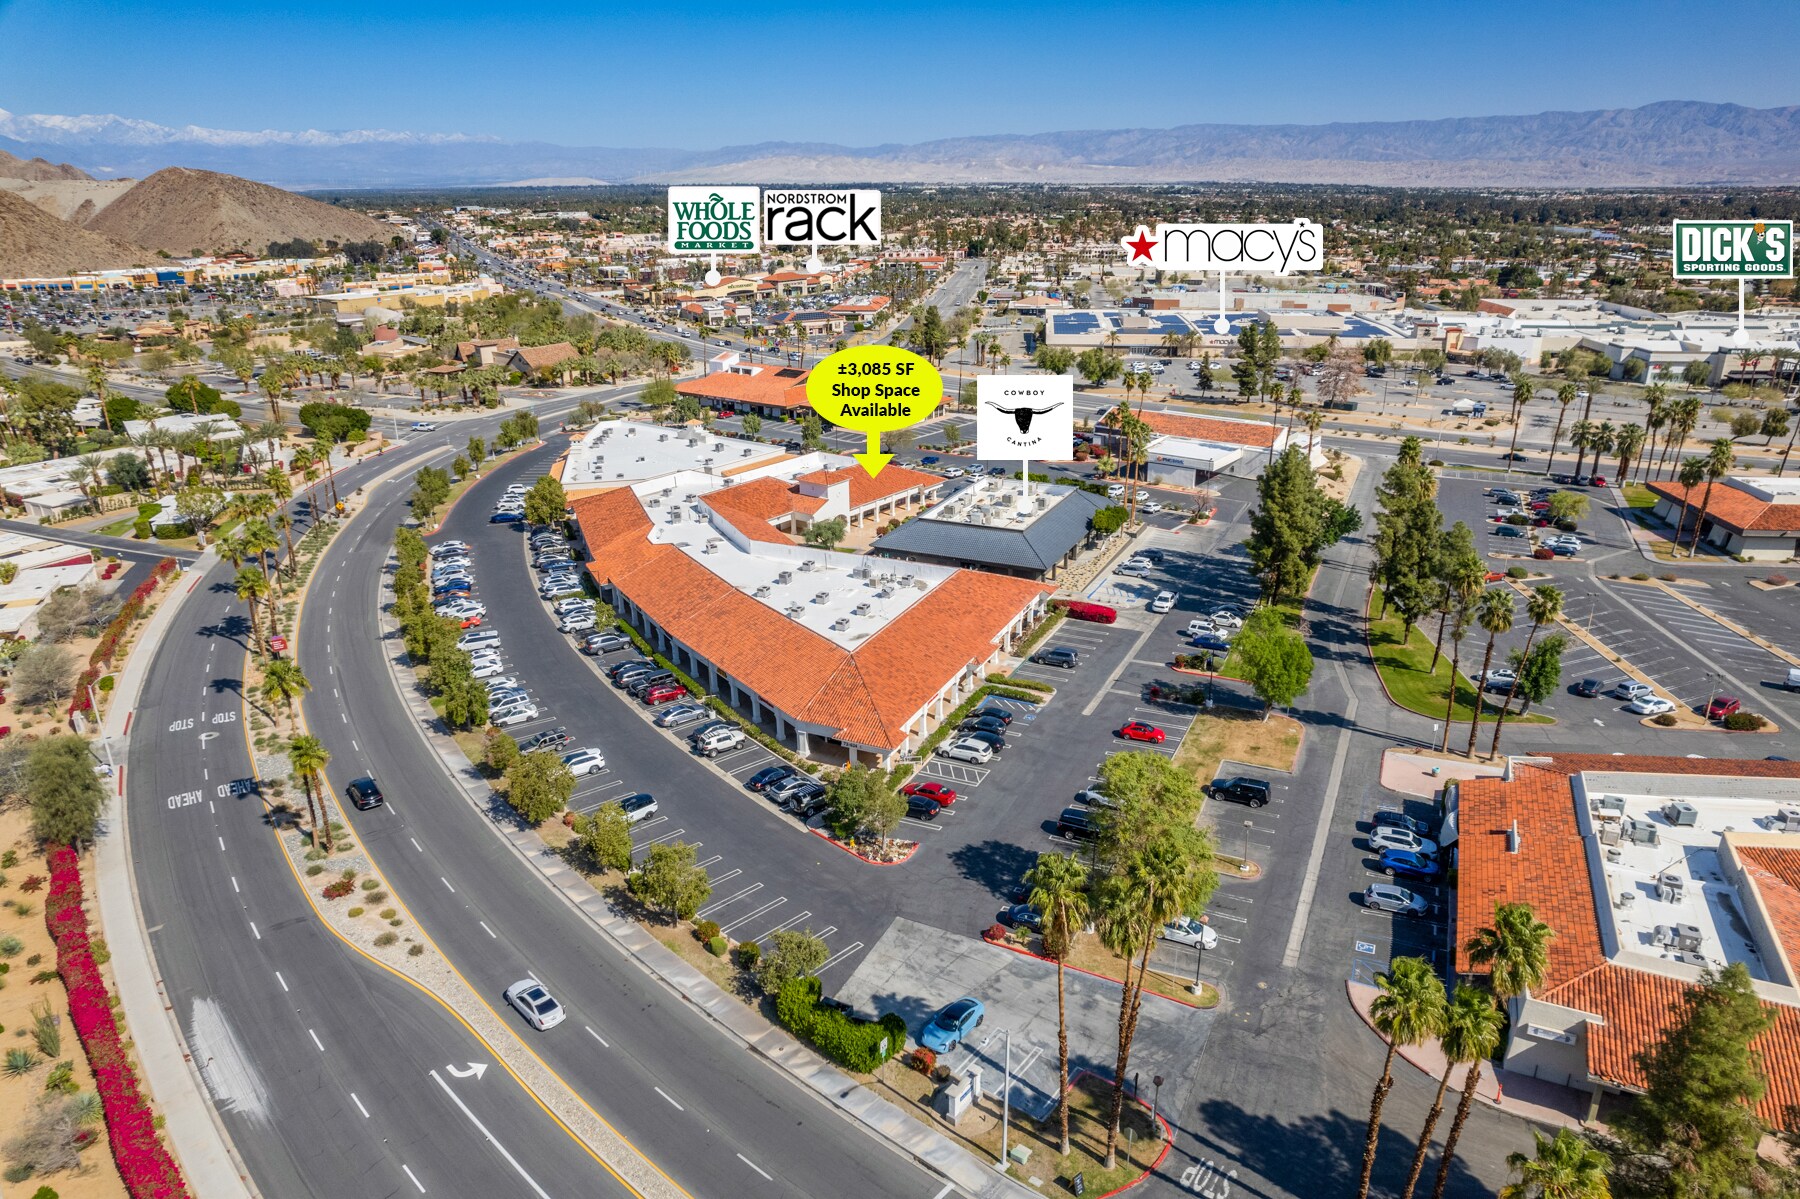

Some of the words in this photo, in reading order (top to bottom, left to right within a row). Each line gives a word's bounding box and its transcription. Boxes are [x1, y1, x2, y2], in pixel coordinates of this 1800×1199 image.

[168, 718, 194, 732] STOP
[212, 711, 236, 725] STOP
[216, 779, 252, 798] AHEAD
[167, 789, 203, 810] AHEAD
[1179, 1157, 1239, 1199] STOP
